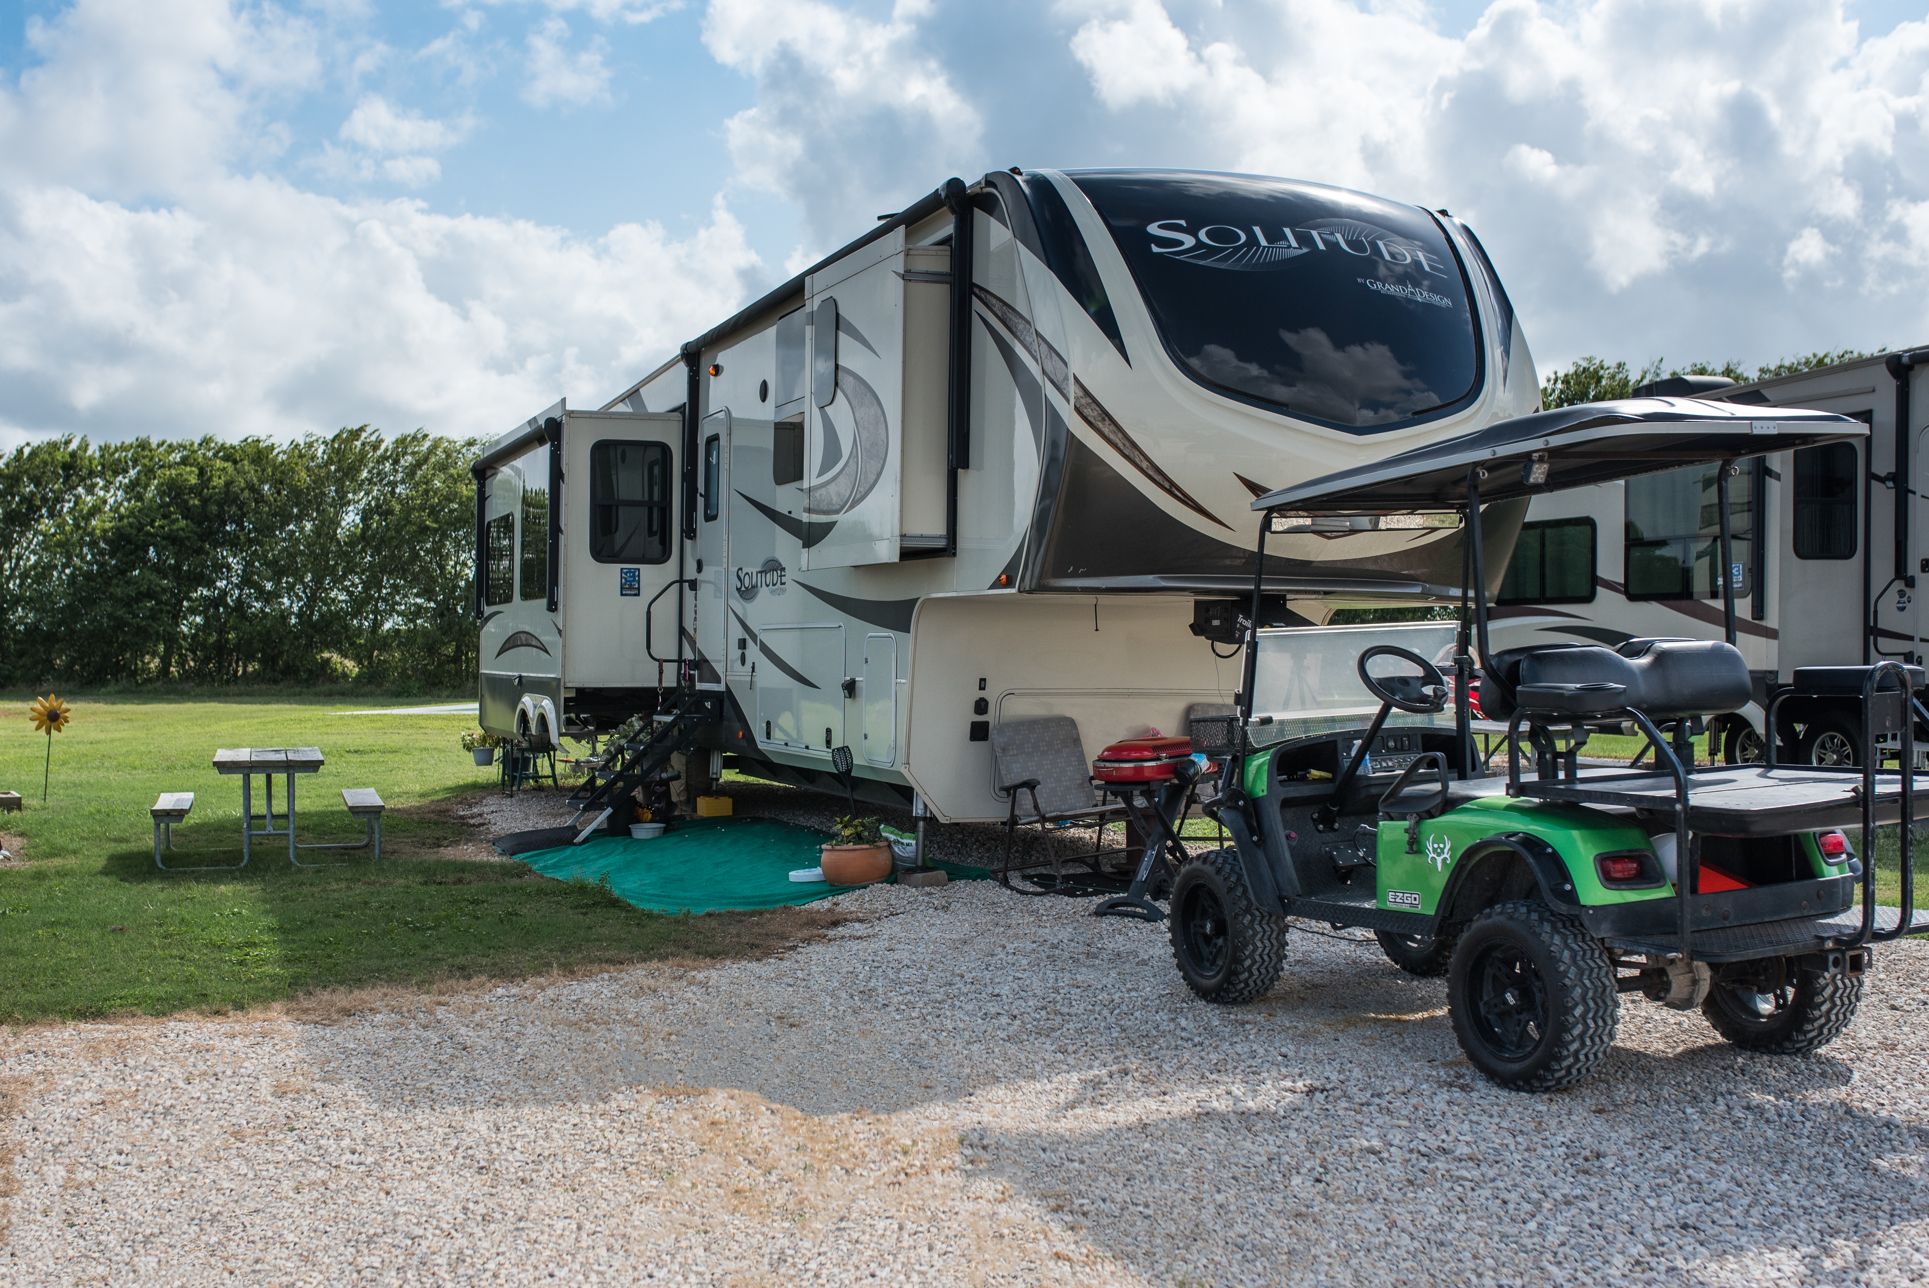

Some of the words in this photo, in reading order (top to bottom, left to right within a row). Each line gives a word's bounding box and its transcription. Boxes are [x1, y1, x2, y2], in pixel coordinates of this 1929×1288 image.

[1146, 219, 1448, 279] SOLITUDE
[1366, 279, 1408, 294] GRAND
[1415, 287, 1453, 306] DESIGN
[735, 566, 786, 590] SOLITUDE
